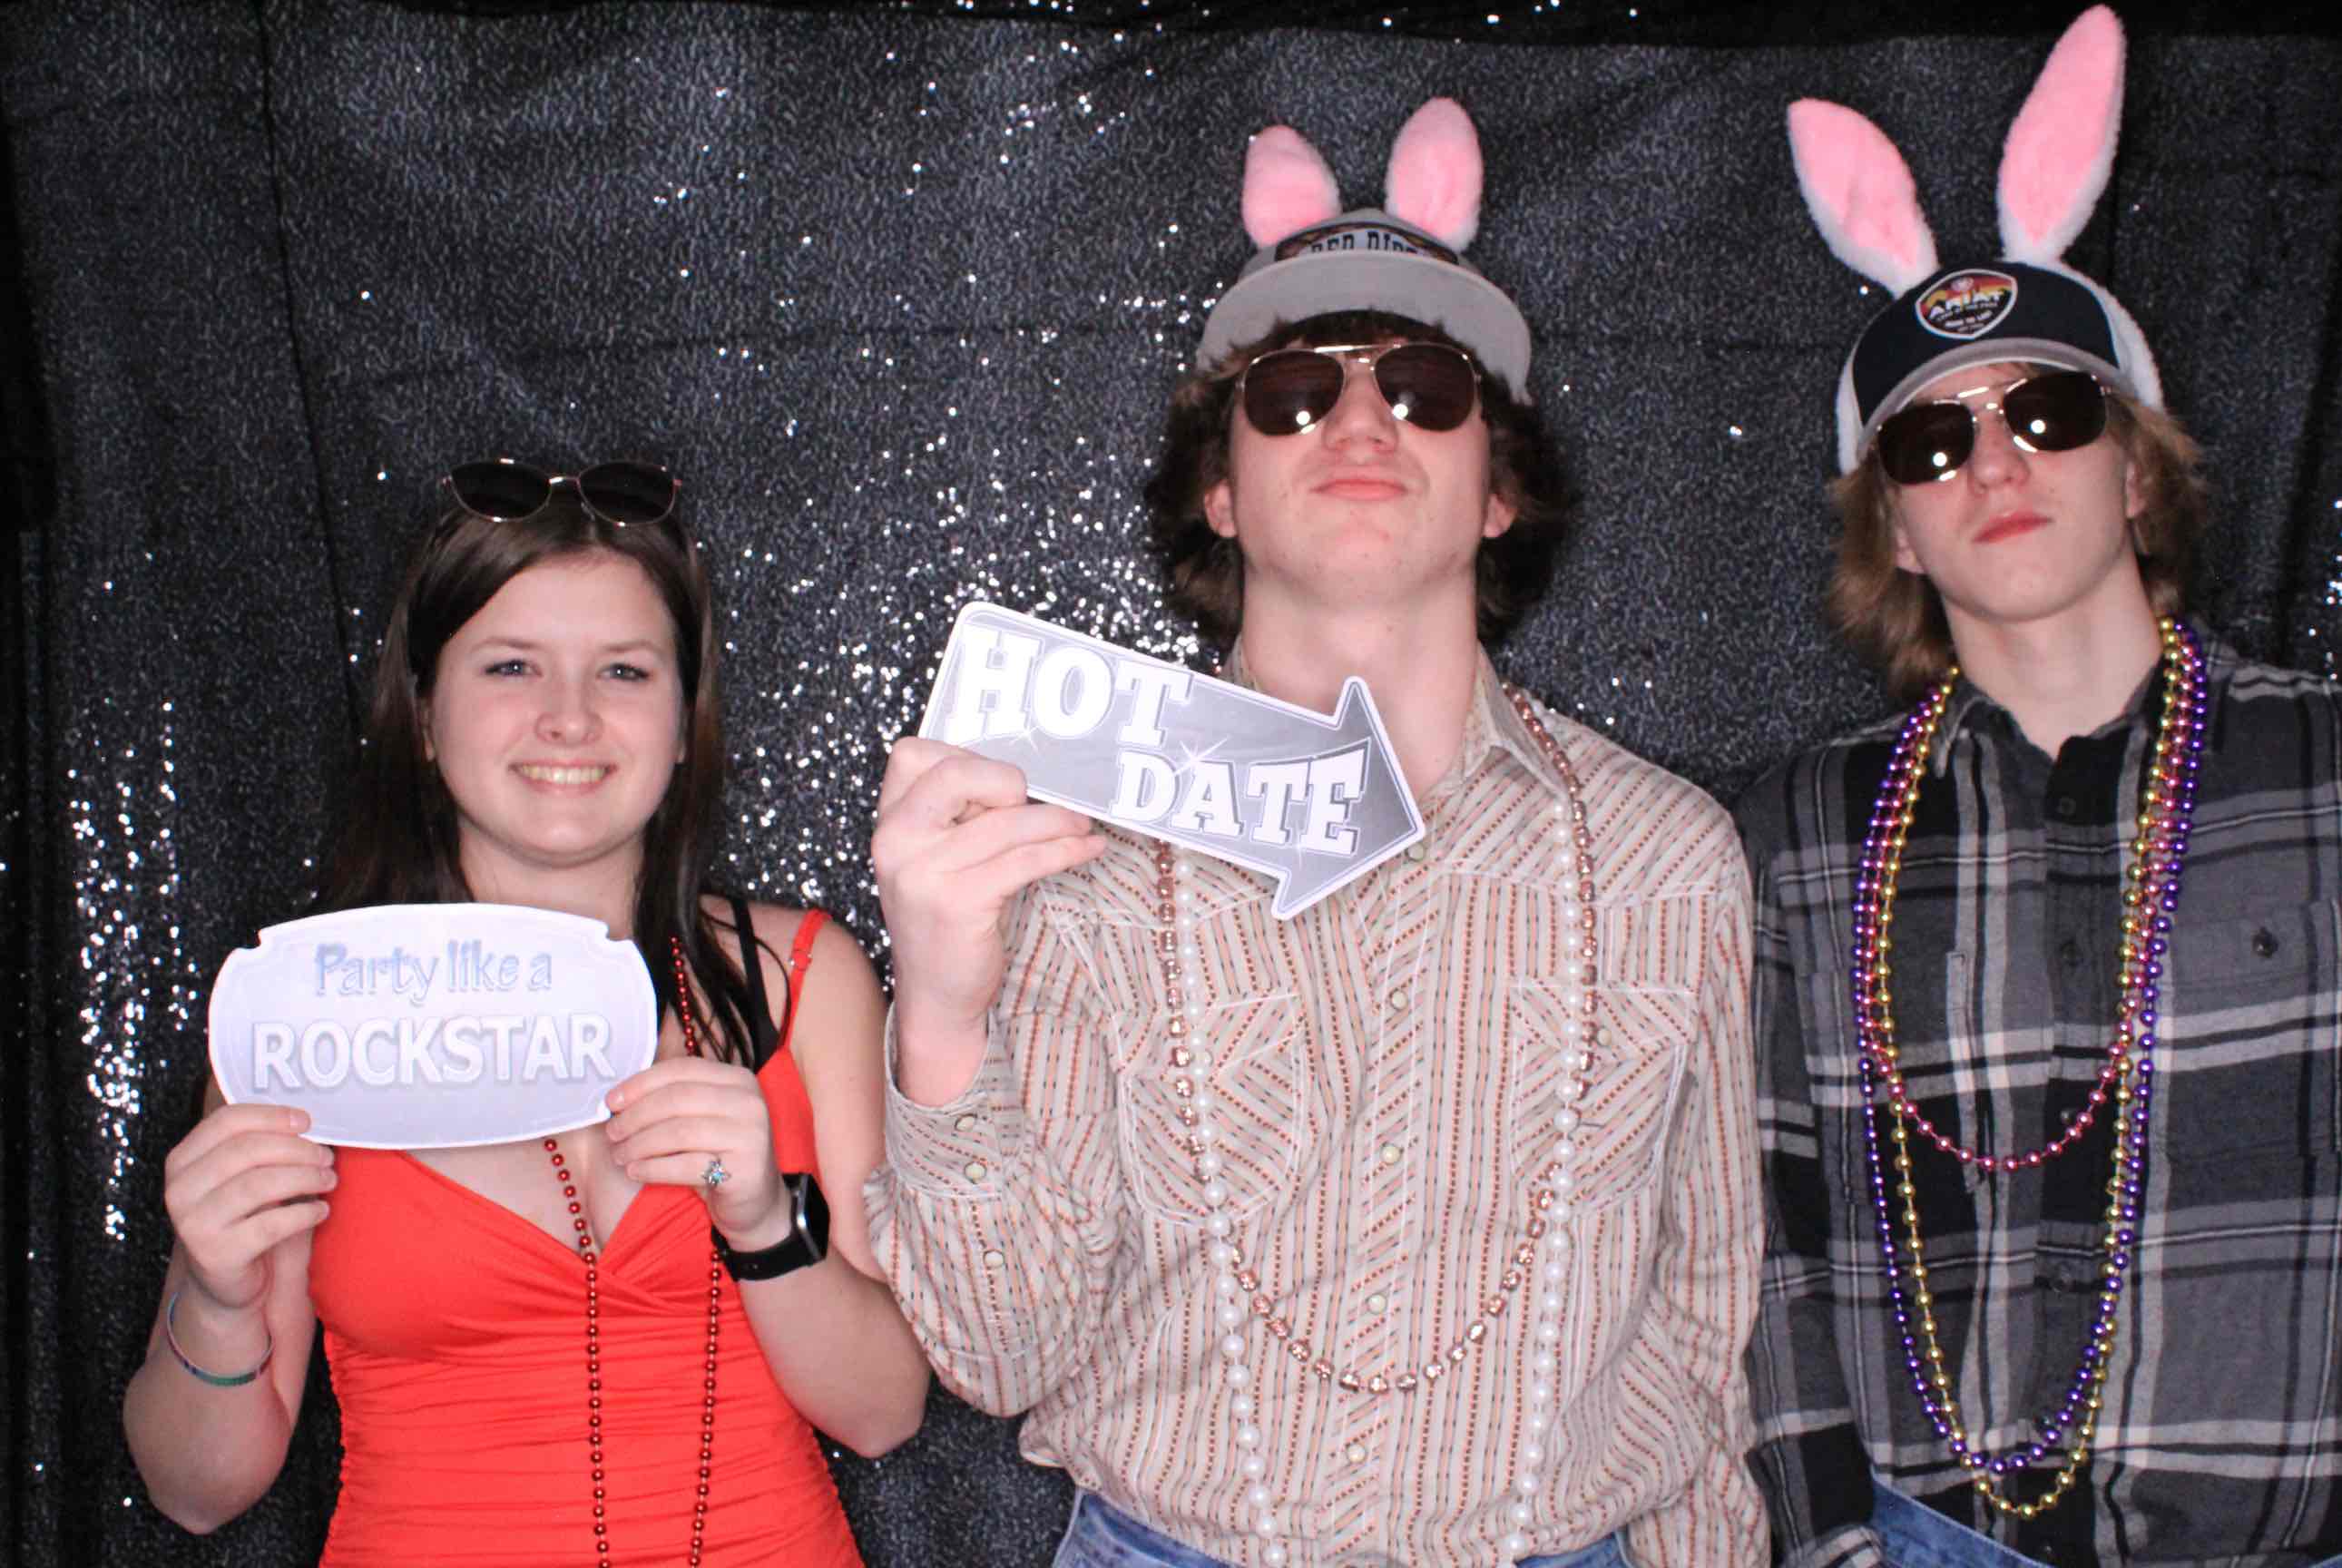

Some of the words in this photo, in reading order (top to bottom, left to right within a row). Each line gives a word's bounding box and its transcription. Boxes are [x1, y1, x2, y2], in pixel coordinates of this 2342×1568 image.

[944, 624, 1193, 745] HOT
[1111, 740, 1368, 856] DATE
[315, 943, 440, 1006] Party
[448, 940, 521, 993] like
[528, 952, 553, 991] a
[253, 1014, 617, 1090] ROCKSTAR
